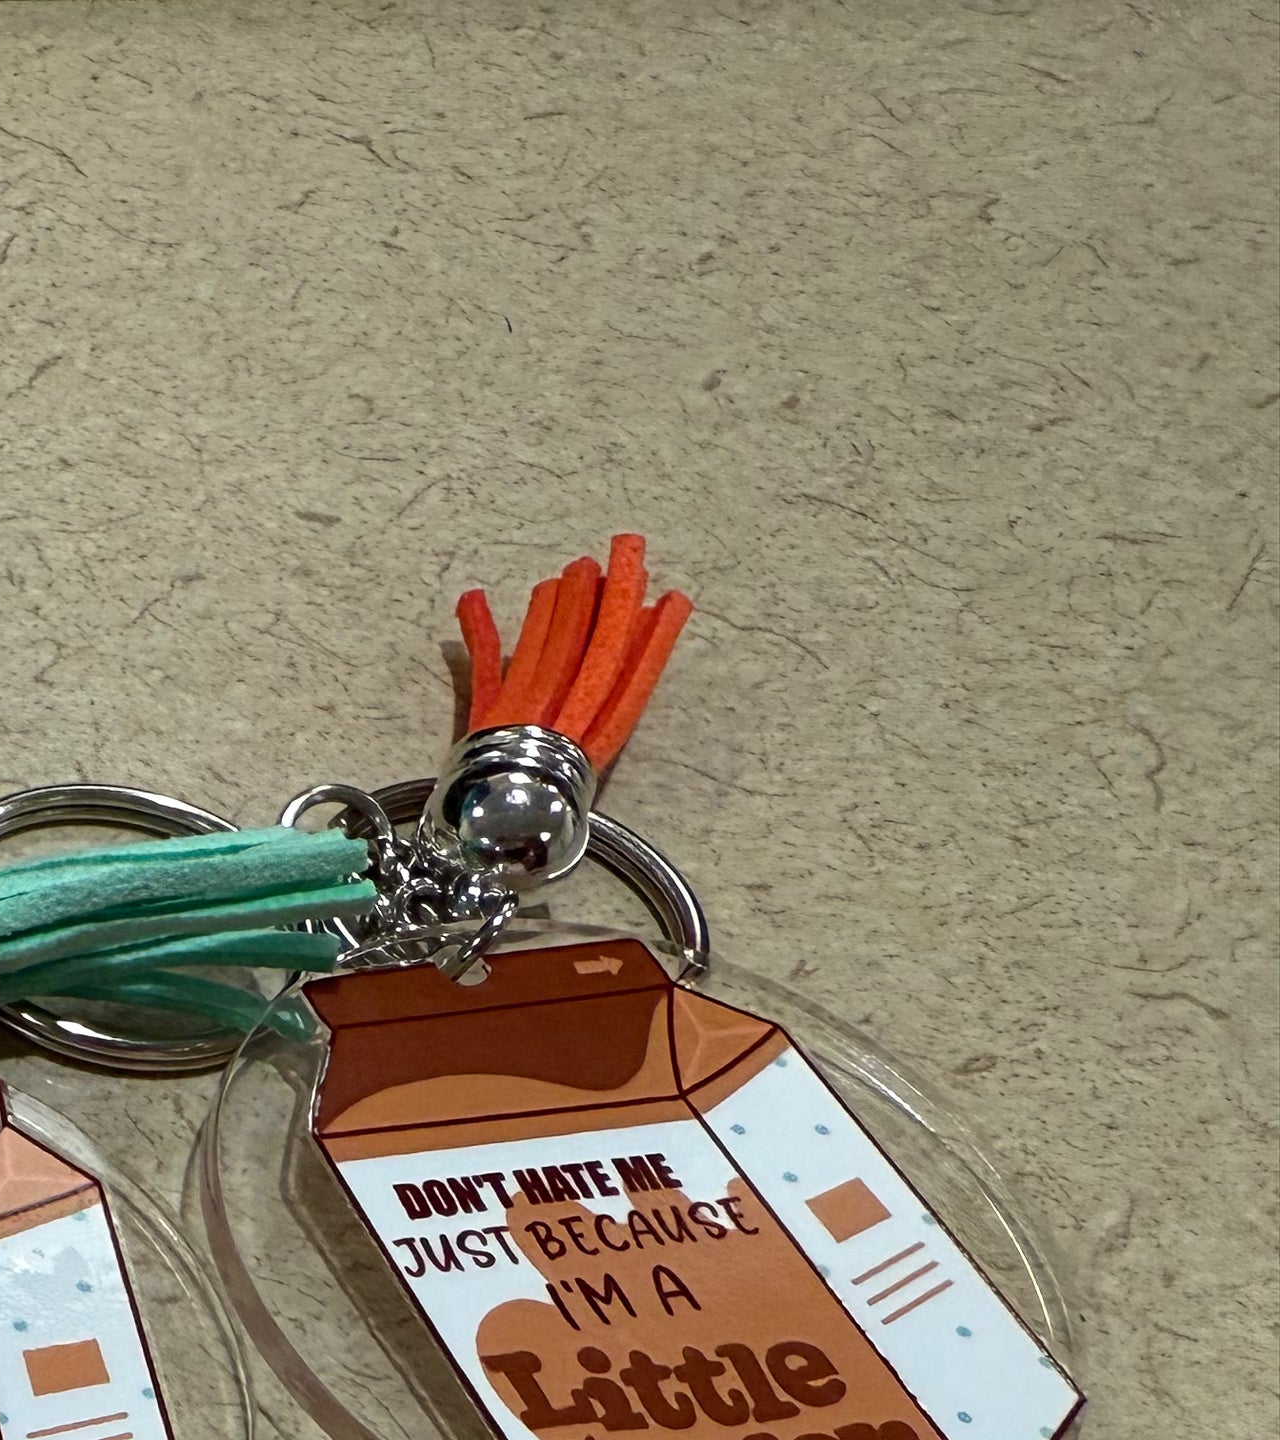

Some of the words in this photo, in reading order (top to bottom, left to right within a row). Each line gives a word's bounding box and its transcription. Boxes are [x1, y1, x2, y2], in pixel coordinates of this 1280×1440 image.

[393, 1170, 511, 1220] DON'T
[513, 1160, 620, 1205] HATE
[617, 1153, 682, 1192] ME
[392, 1229, 520, 1278] JUST
[525, 1197, 760, 1261] BECAUSE
[545, 1275, 636, 1331] I'M
[652, 1265, 701, 1315] A
[480, 1341, 847, 1431] Little
